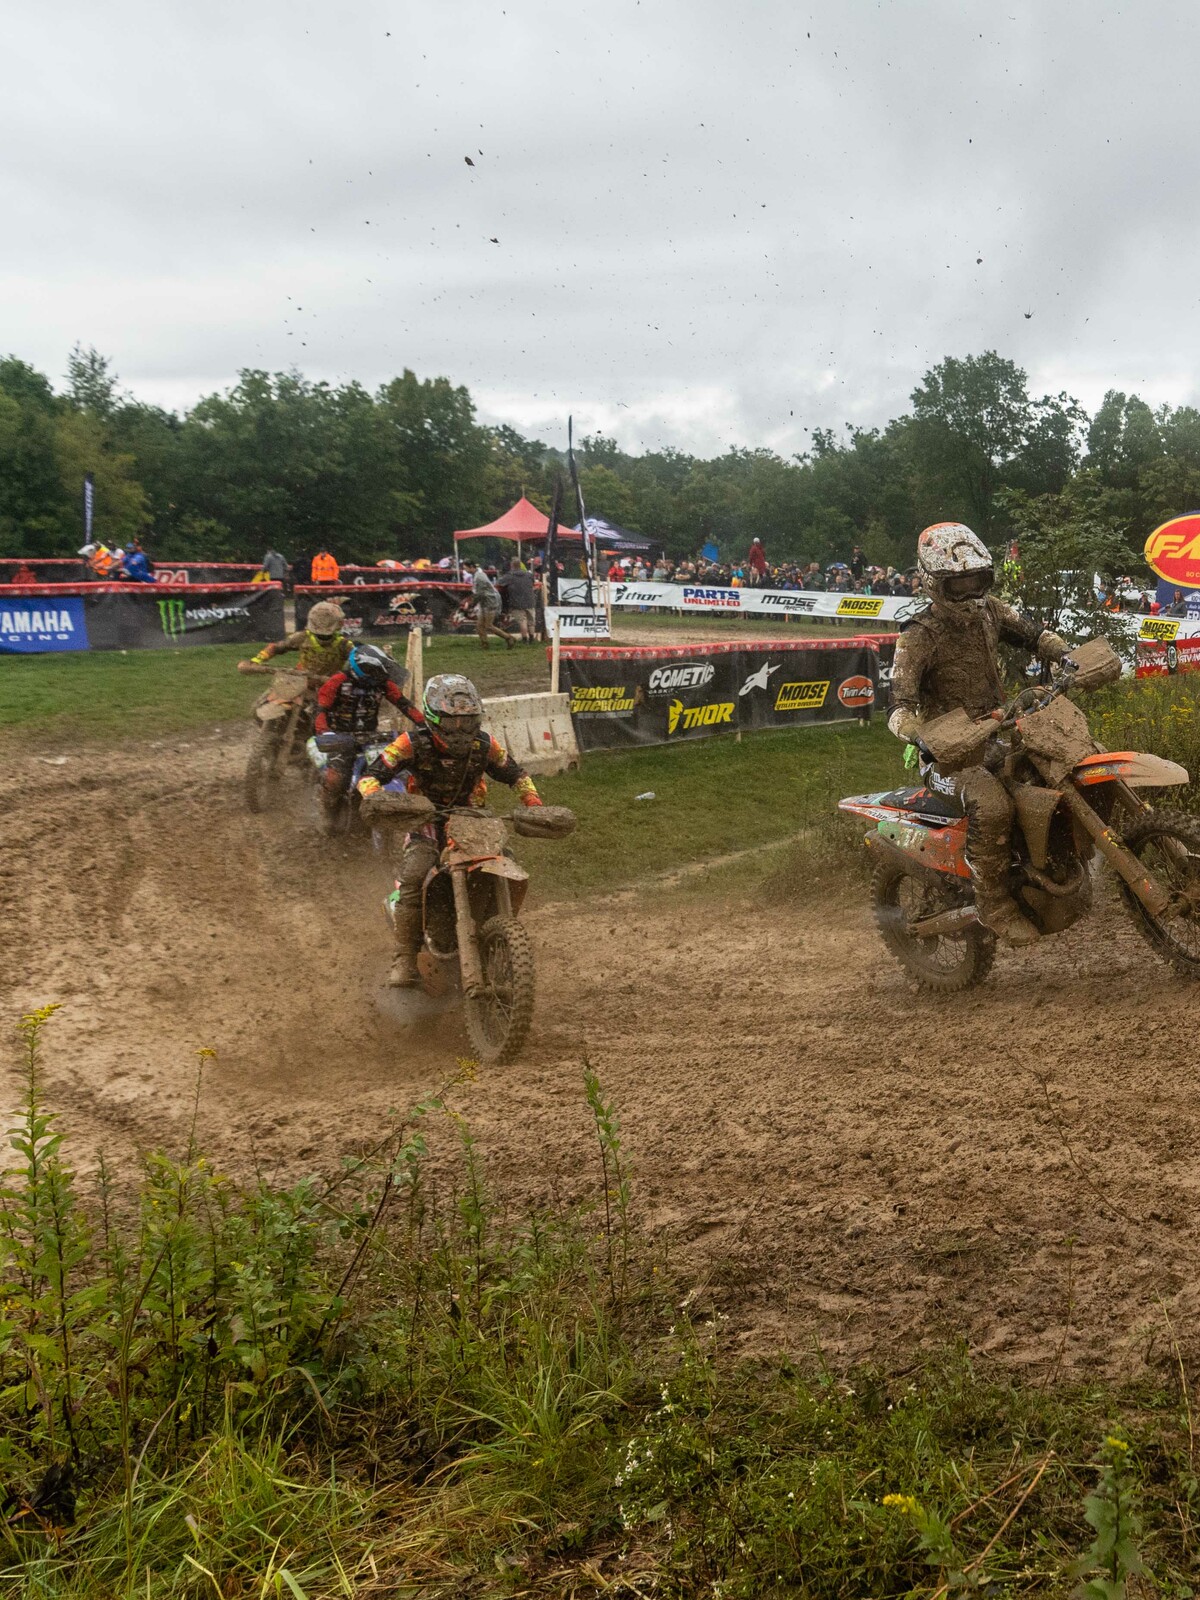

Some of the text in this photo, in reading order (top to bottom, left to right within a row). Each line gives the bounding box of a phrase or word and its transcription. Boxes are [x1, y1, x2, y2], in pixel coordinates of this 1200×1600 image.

[683, 588, 740, 600] PARTS
[684, 598, 740, 607] UNLIMITED
[761, 595, 818, 608] MOOSE
[841, 599, 880, 611] MOOSE
[185, 607, 250, 620] MONSTER
[0, 610, 74, 634] AMAHA
[559, 614, 607, 627] MOOS
[583, 626, 609, 634] RACIN
[1143, 621, 1177, 635] MOOSE
[0, 632, 70, 642] CING
[649, 665, 715, 689] COMETIC
[571, 686, 626, 700] Factory
[780, 683, 828, 702] MOOSE
[842, 687, 859, 699] Twin
[858, 685, 874, 697] Air
[571, 698, 635, 713] onnection
[683, 702, 736, 729] THOR
